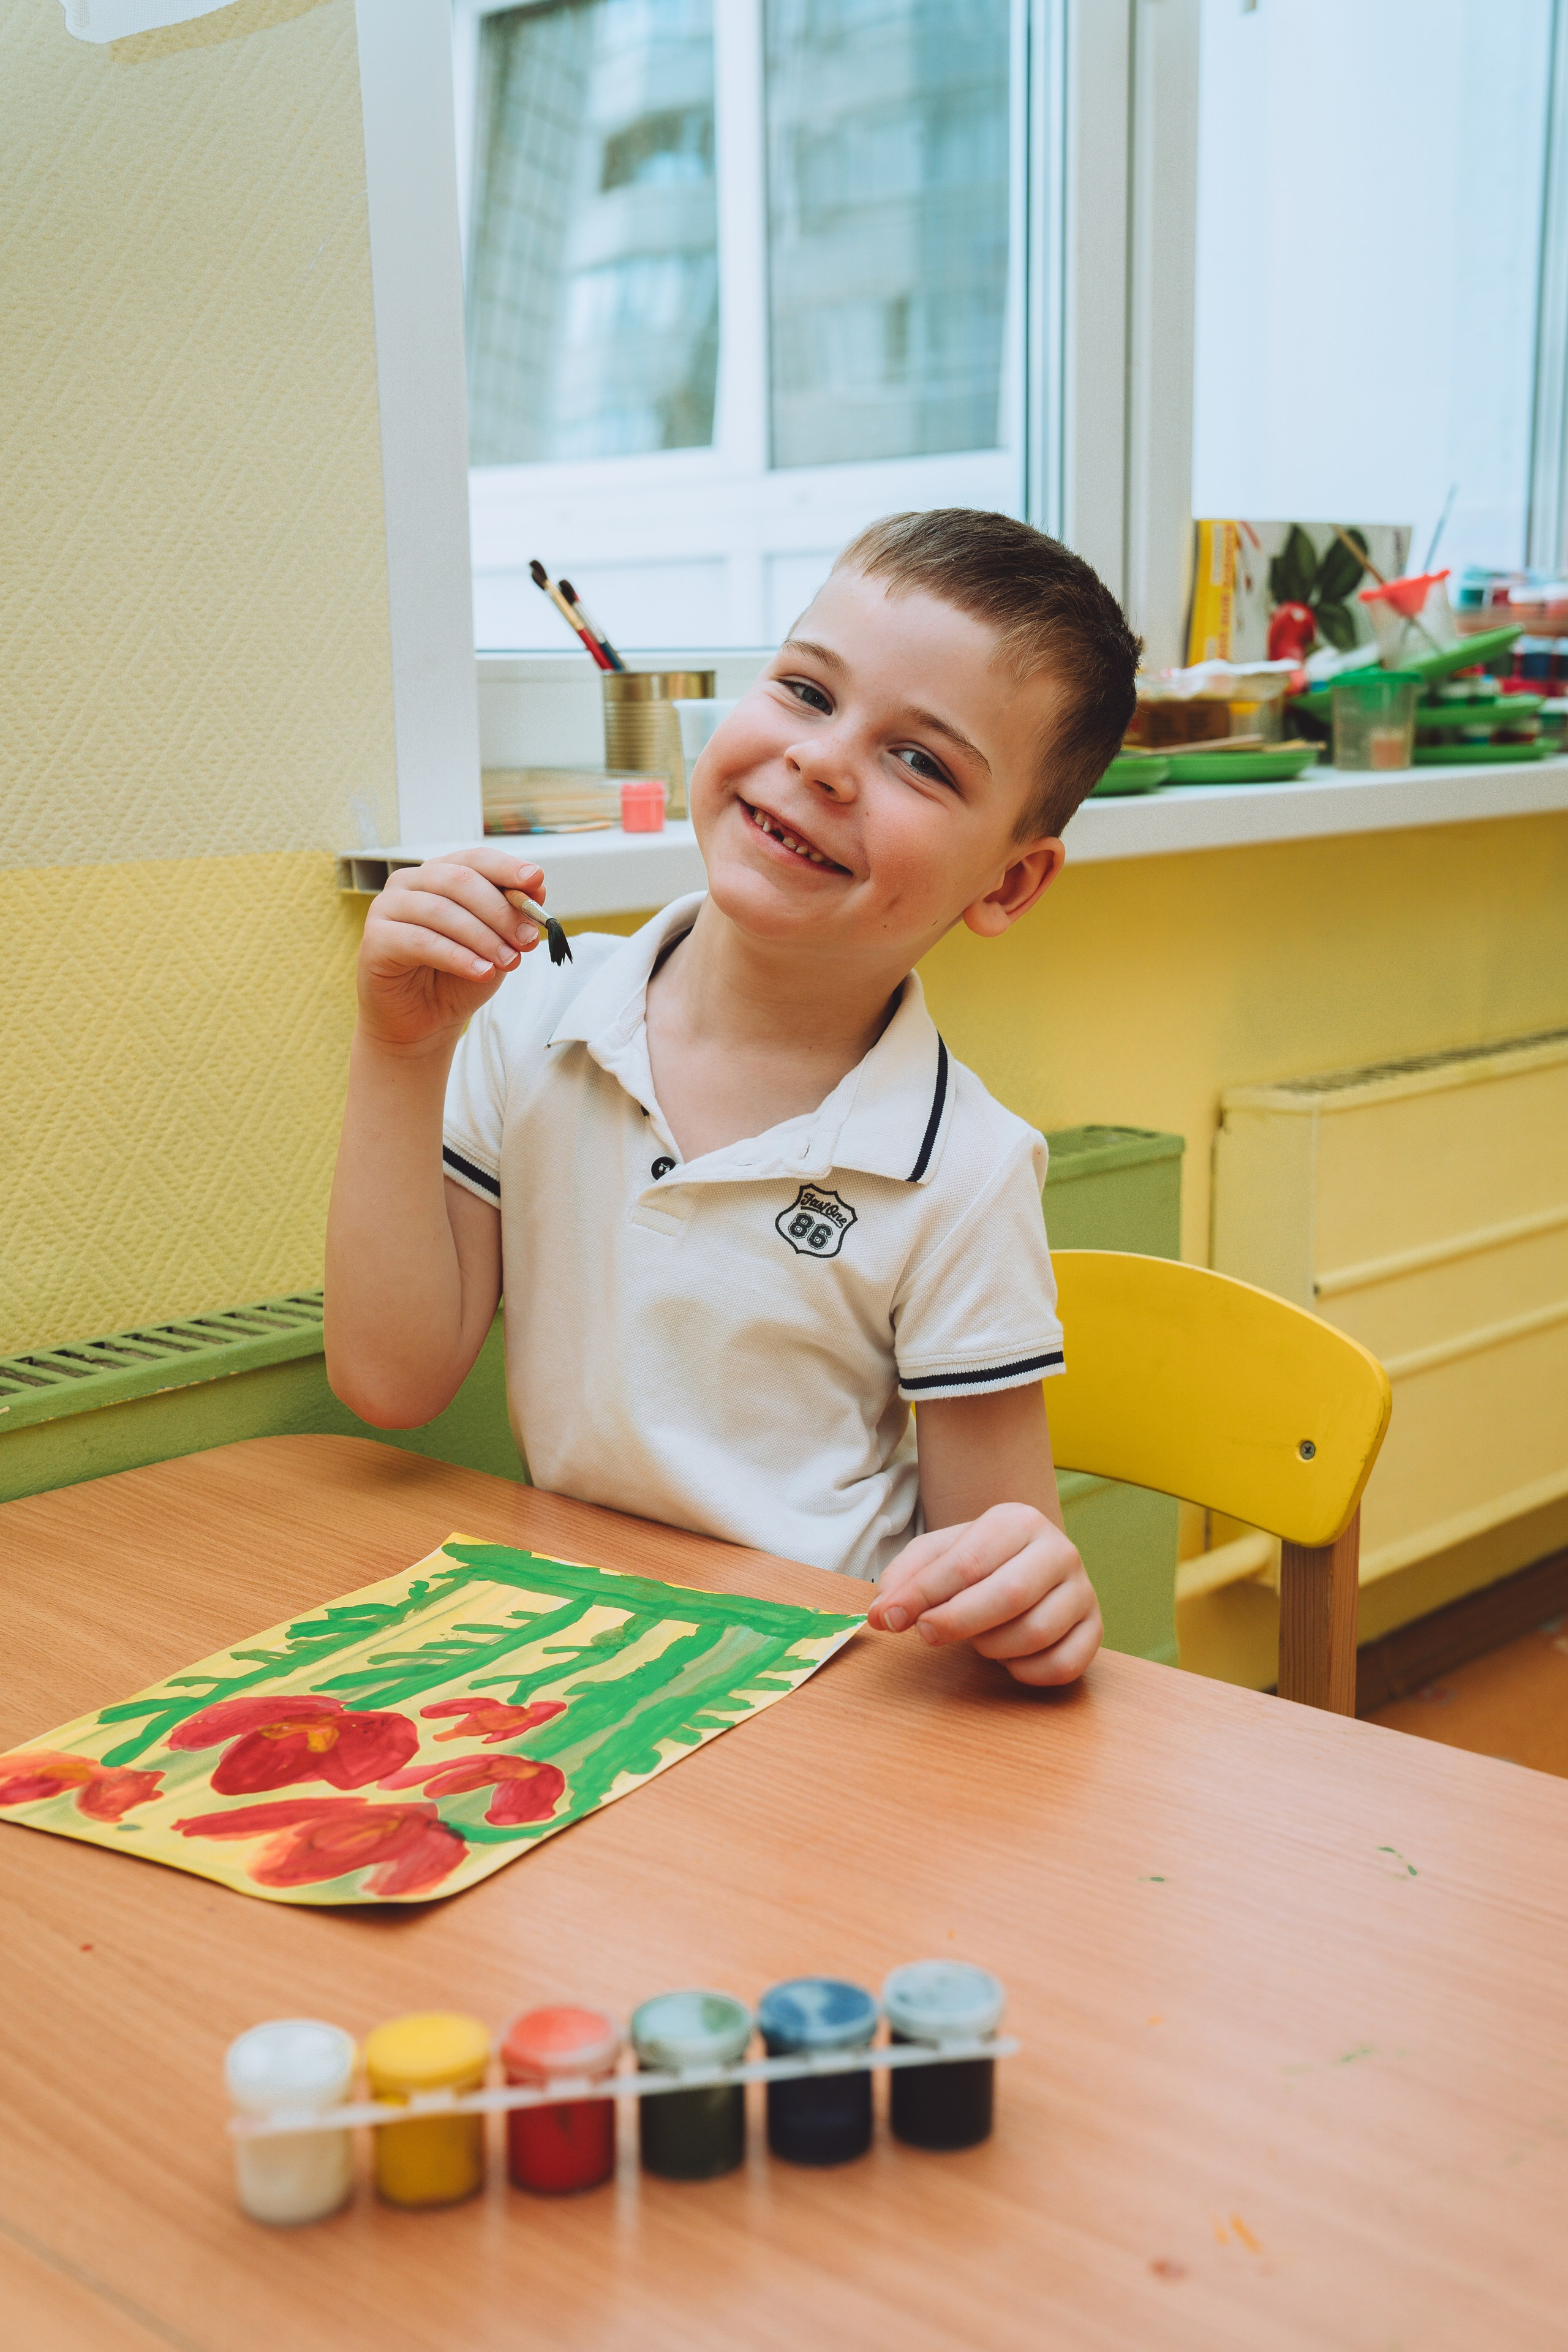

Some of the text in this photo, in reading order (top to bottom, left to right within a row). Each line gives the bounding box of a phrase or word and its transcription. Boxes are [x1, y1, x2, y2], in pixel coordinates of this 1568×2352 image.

[801, 1193, 848, 1224] Fast One
[788, 1213, 834, 1250] 86
